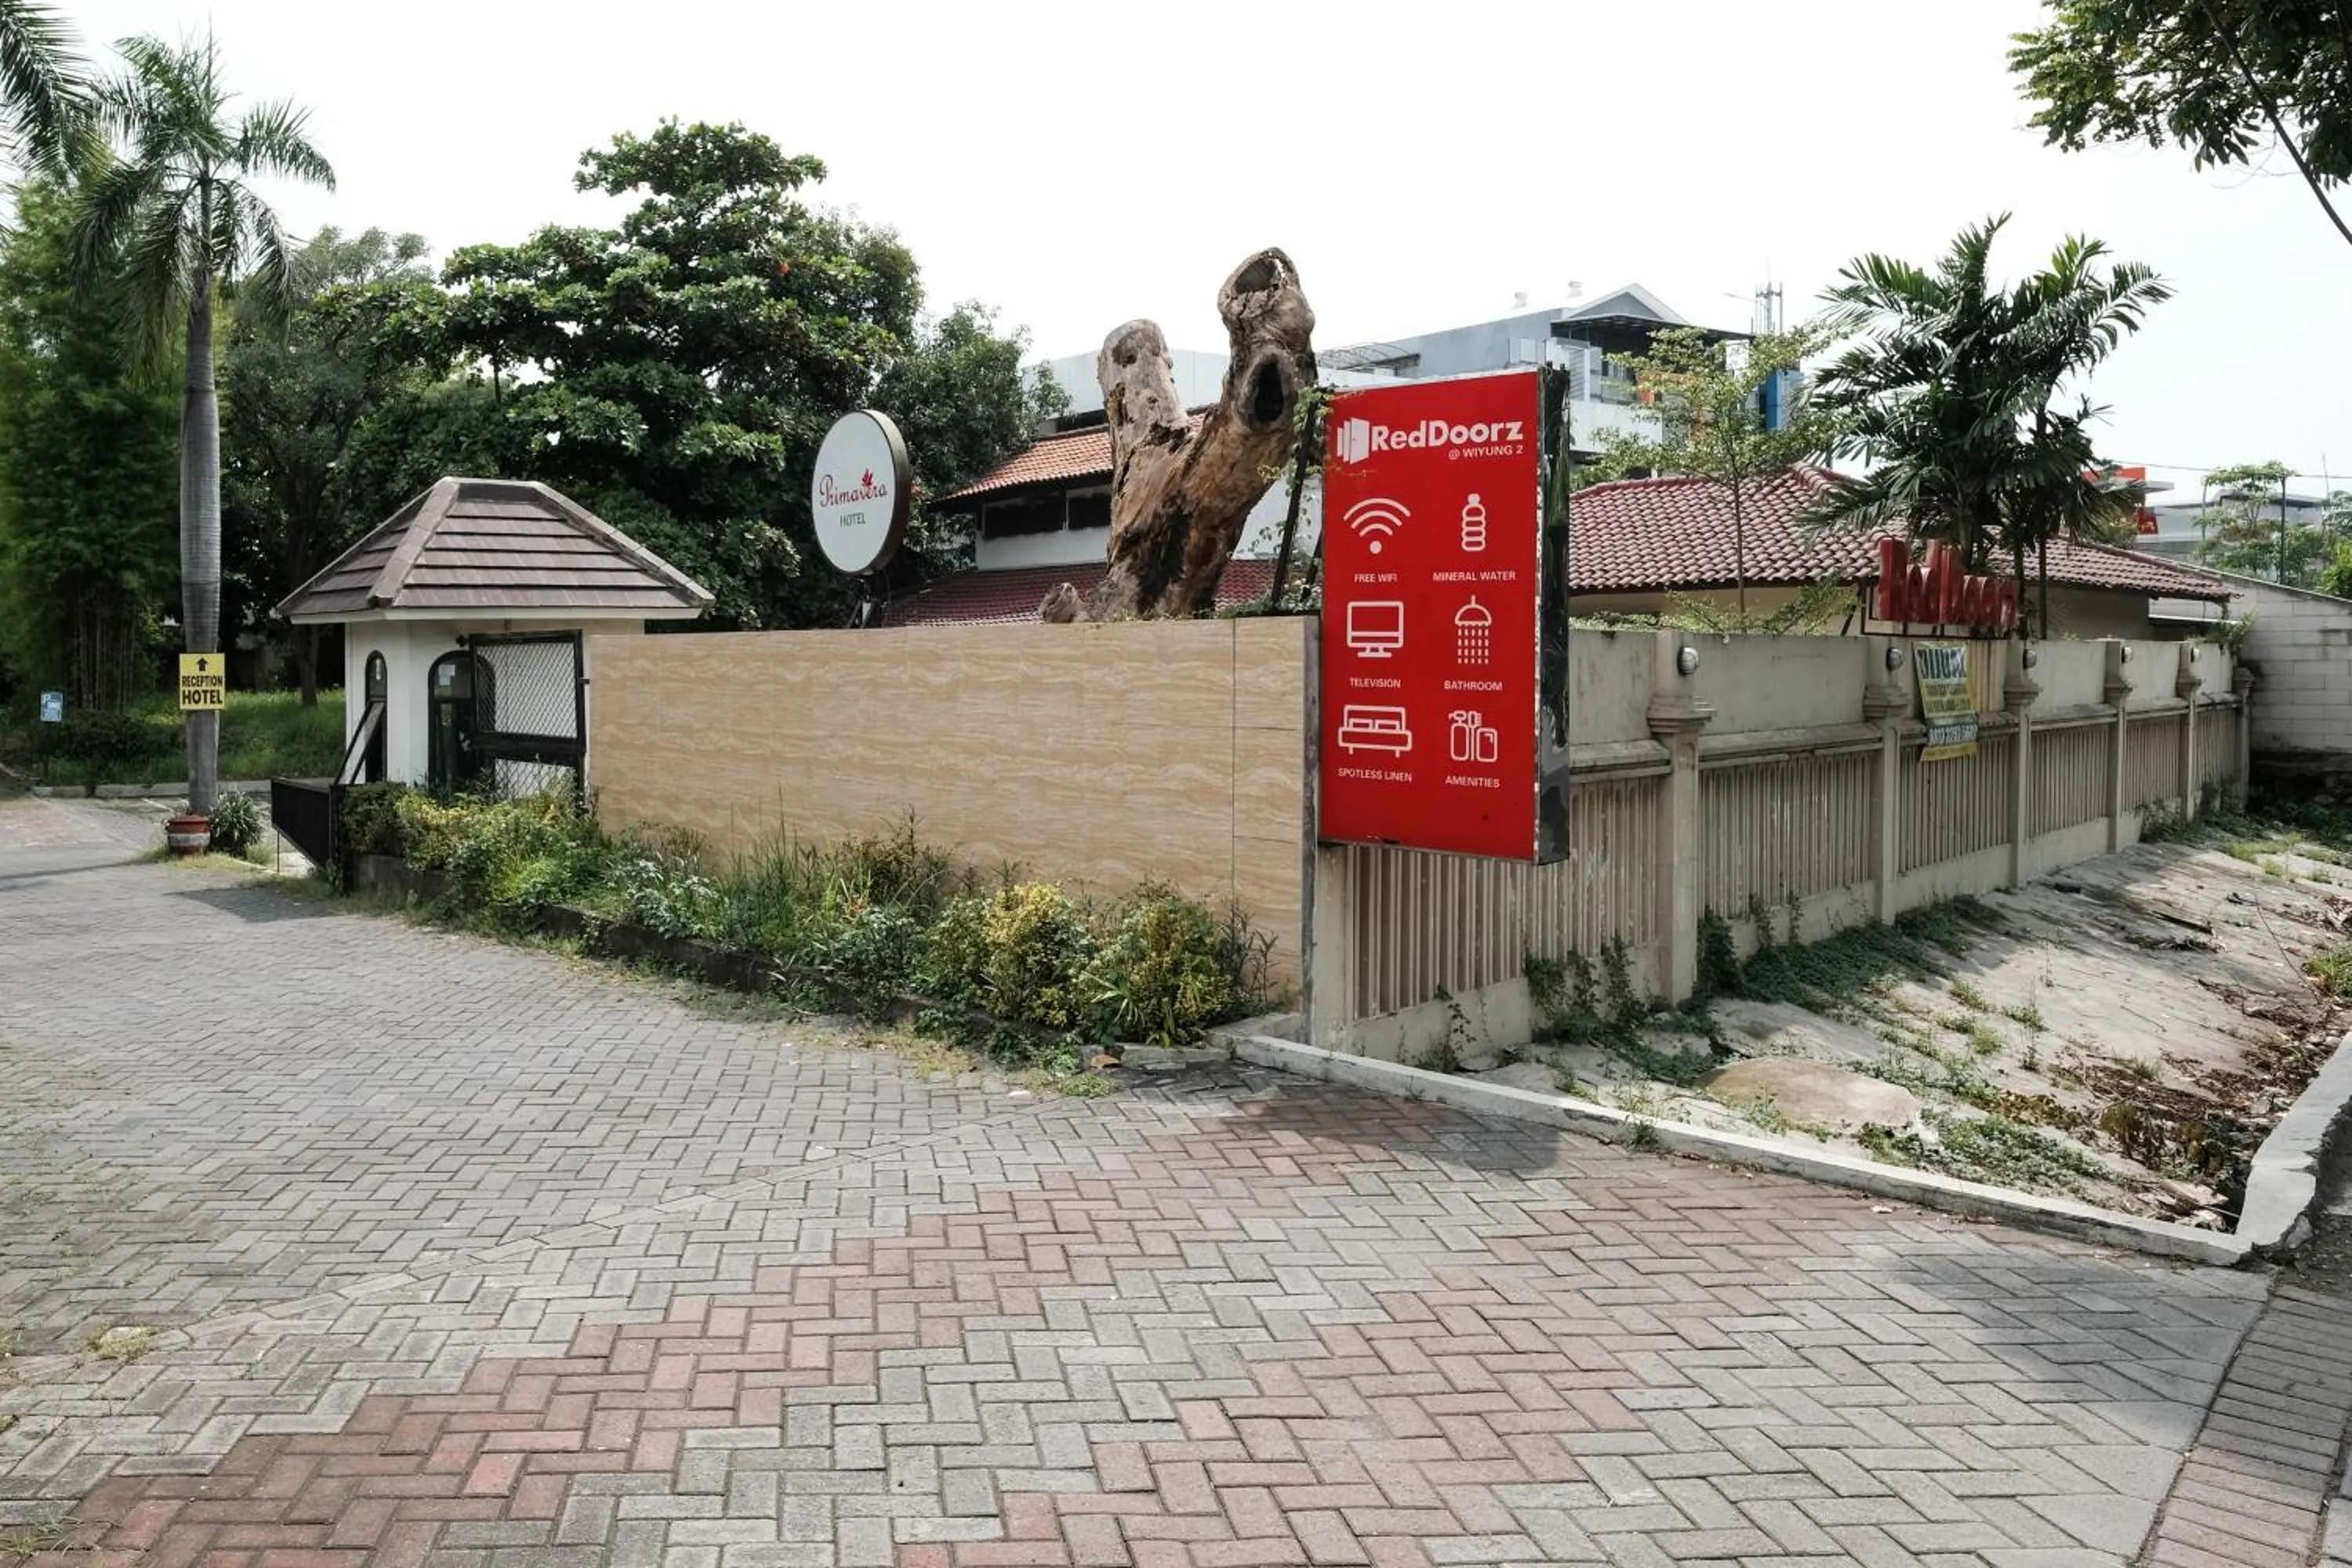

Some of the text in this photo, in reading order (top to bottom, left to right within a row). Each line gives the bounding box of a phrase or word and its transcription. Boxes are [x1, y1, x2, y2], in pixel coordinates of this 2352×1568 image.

[1372, 419, 1523, 452] RedDoorz
[1448, 445, 1523, 460] @ WIYUNG 2
[819, 474, 887, 507] Primavera
[840, 513, 866, 527] HOTEL
[1354, 573, 1376, 583] FREE
[1432, 571, 1516, 582] MINERAL WATER
[182, 675, 223, 688] RECEPTION
[1349, 677, 1401, 688] TELEVISION
[1444, 680, 1503, 691] BATHROOM
[182, 690, 223, 704] HOTEL
[1338, 768, 1412, 782] SPOTLESS LINEN
[1445, 775, 1500, 788] AMENITIES
